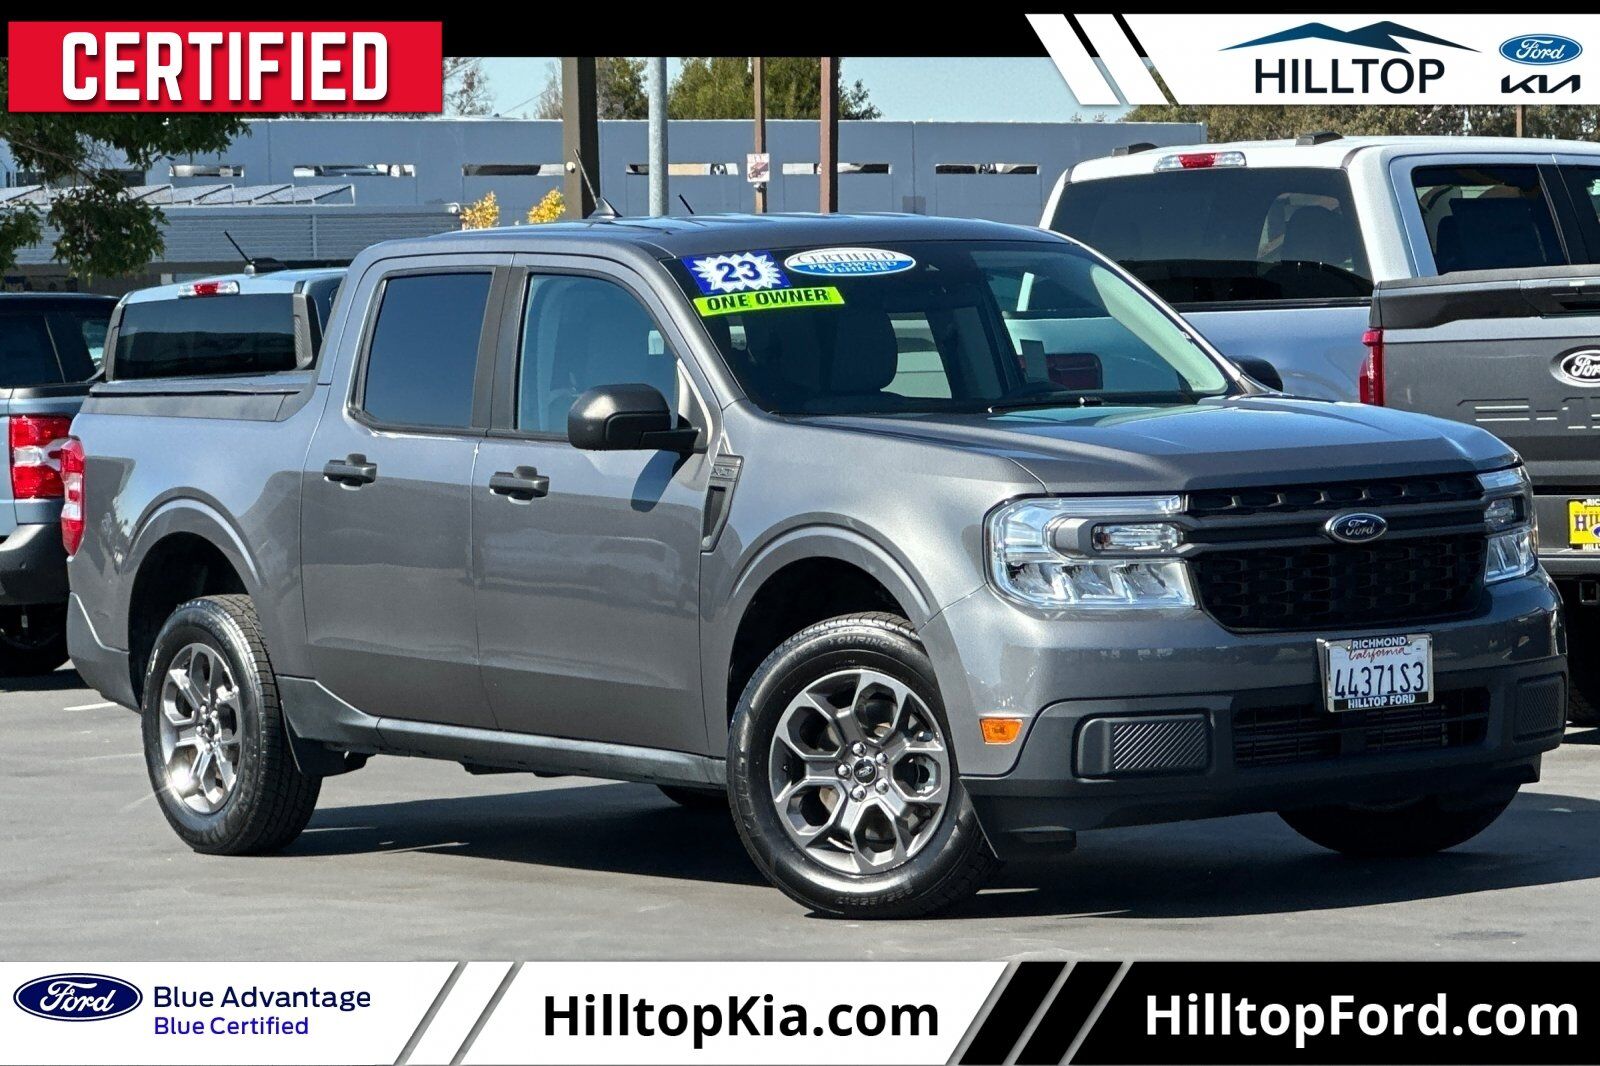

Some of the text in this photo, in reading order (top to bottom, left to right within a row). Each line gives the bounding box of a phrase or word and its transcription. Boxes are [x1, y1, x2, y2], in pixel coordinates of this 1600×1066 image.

[797, 252, 896, 264] CERTIFIED
[716, 260, 762, 282] 23
[707, 288, 829, 311] ONE OWNER
[1345, 519, 1375, 536] Ford
[1352, 636, 1407, 649] RICHMOND
[1348, 647, 1411, 663] California
[1334, 661, 1424, 699] 44371S3
[1347, 693, 1416, 710] HILLTOP FORD
